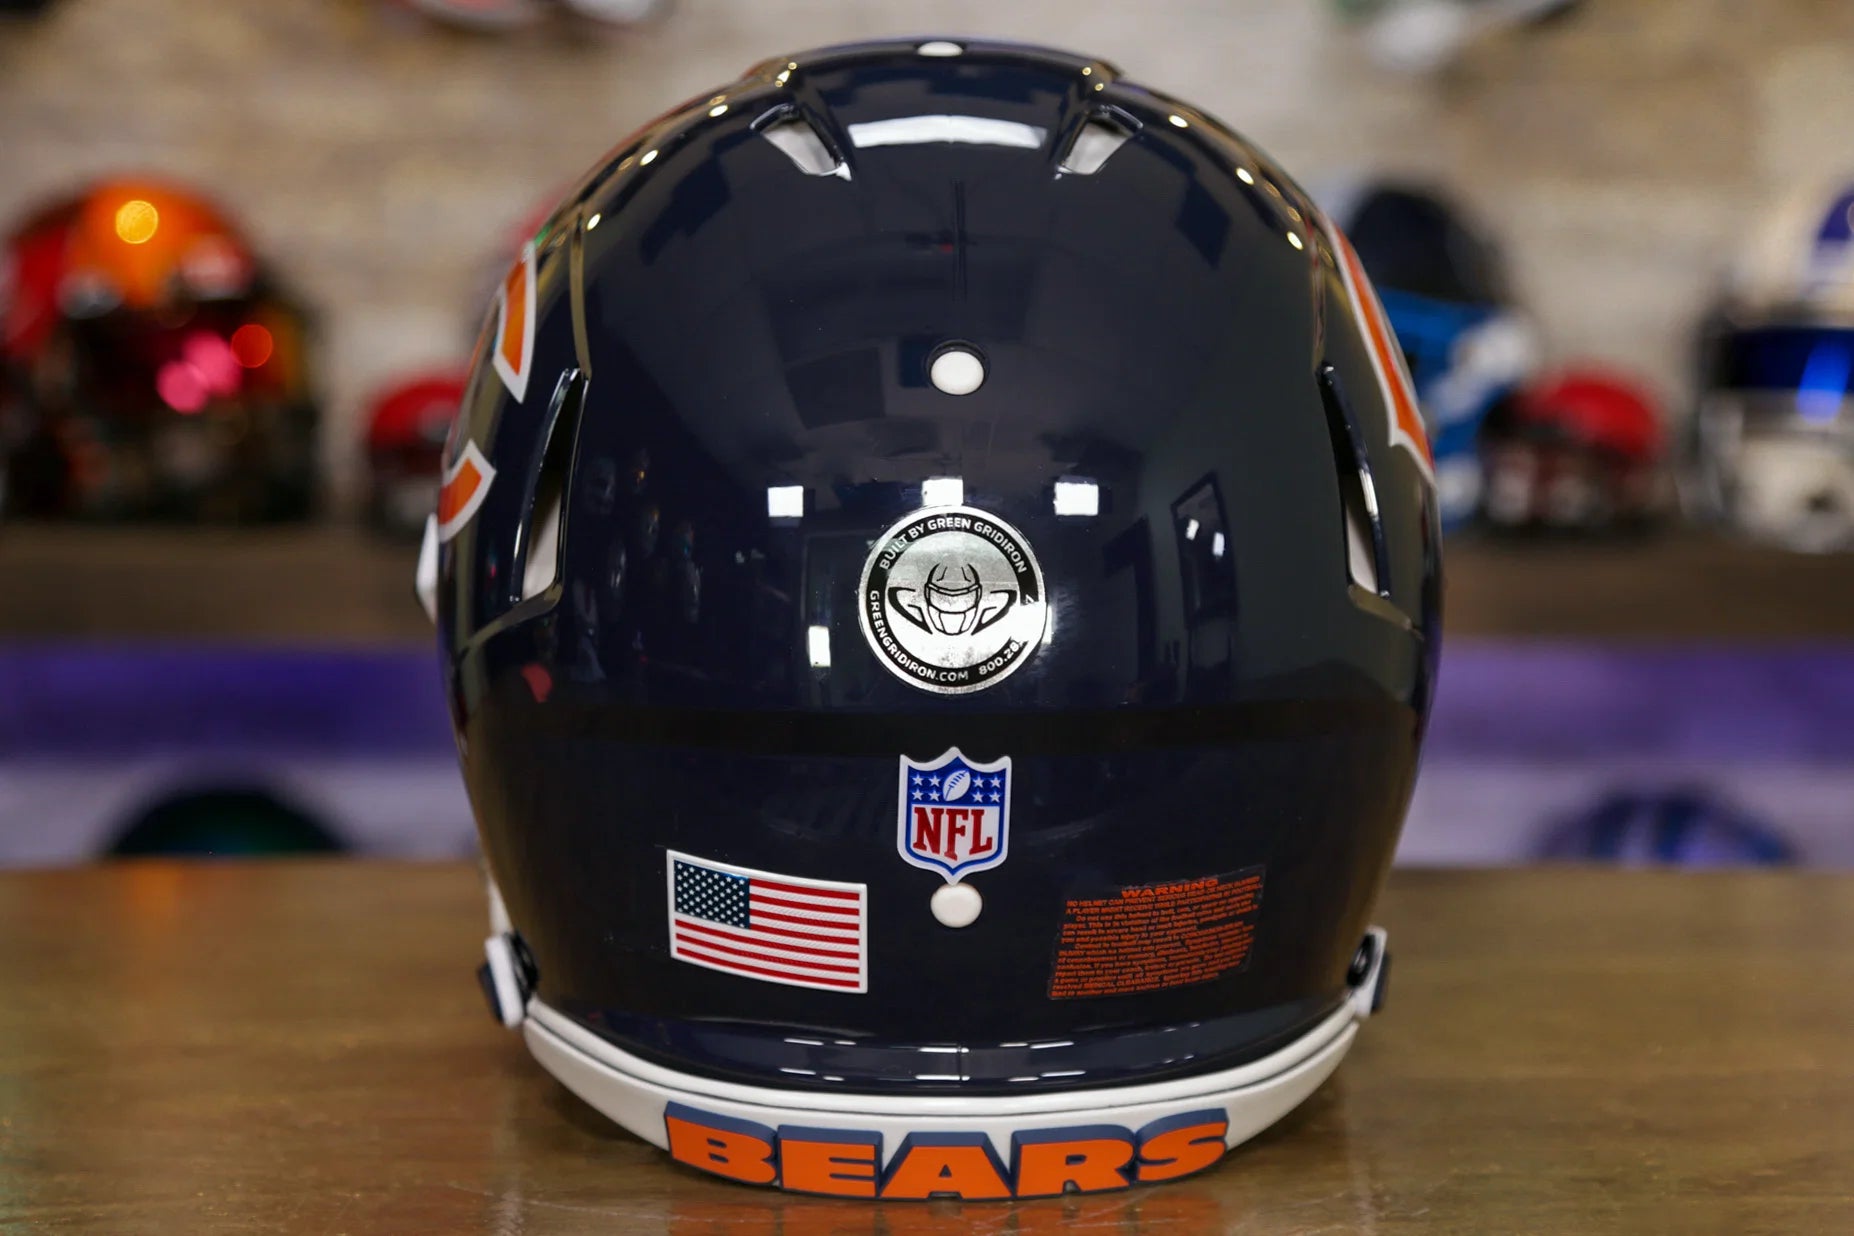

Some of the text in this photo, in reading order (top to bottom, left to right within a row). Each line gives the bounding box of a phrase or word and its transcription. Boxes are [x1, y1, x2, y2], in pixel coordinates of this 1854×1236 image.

[879, 517, 1028, 574] BUILT BY GREEN GRIDIRON
[869, 590, 970, 682] GREENGRIDIRON.COM
[912, 806, 993, 861] NFL
[1121, 878, 1219, 898] WARNING
[664, 1100, 1230, 1201] BEARS
